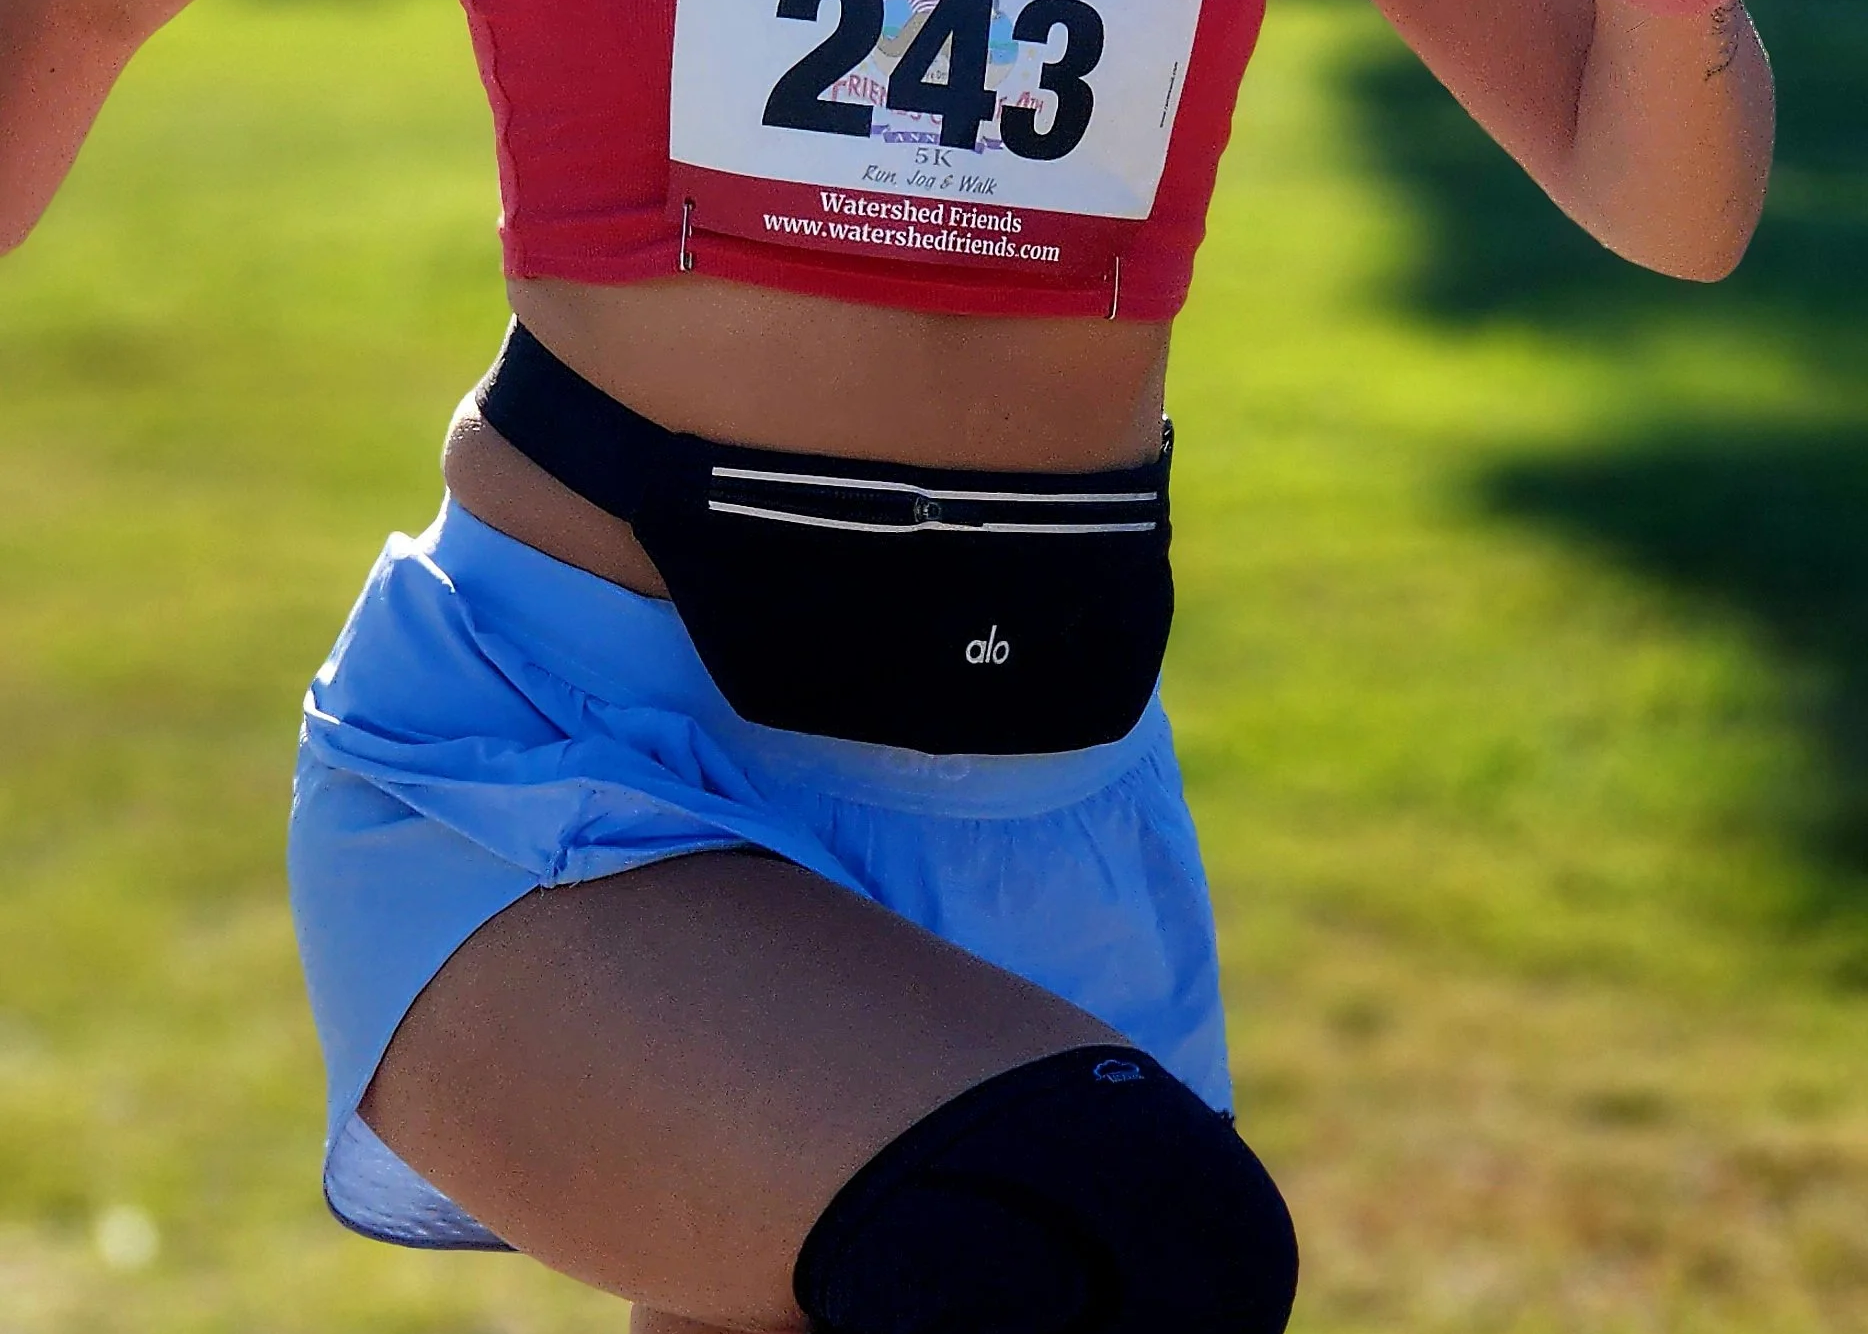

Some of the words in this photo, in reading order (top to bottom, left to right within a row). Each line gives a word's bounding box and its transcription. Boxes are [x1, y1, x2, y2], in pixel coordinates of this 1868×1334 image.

[915, 147, 953, 168] 5K
[907, 170, 937, 192] Jog
[940, 174, 954, 190] &
[959, 175, 998, 196] Walk
[819, 191, 944, 226] Watershed
[948, 206, 1022, 234] Friends
[763, 214, 1061, 262] www.watershedfriends.com
[965, 624, 1010, 665] alo
